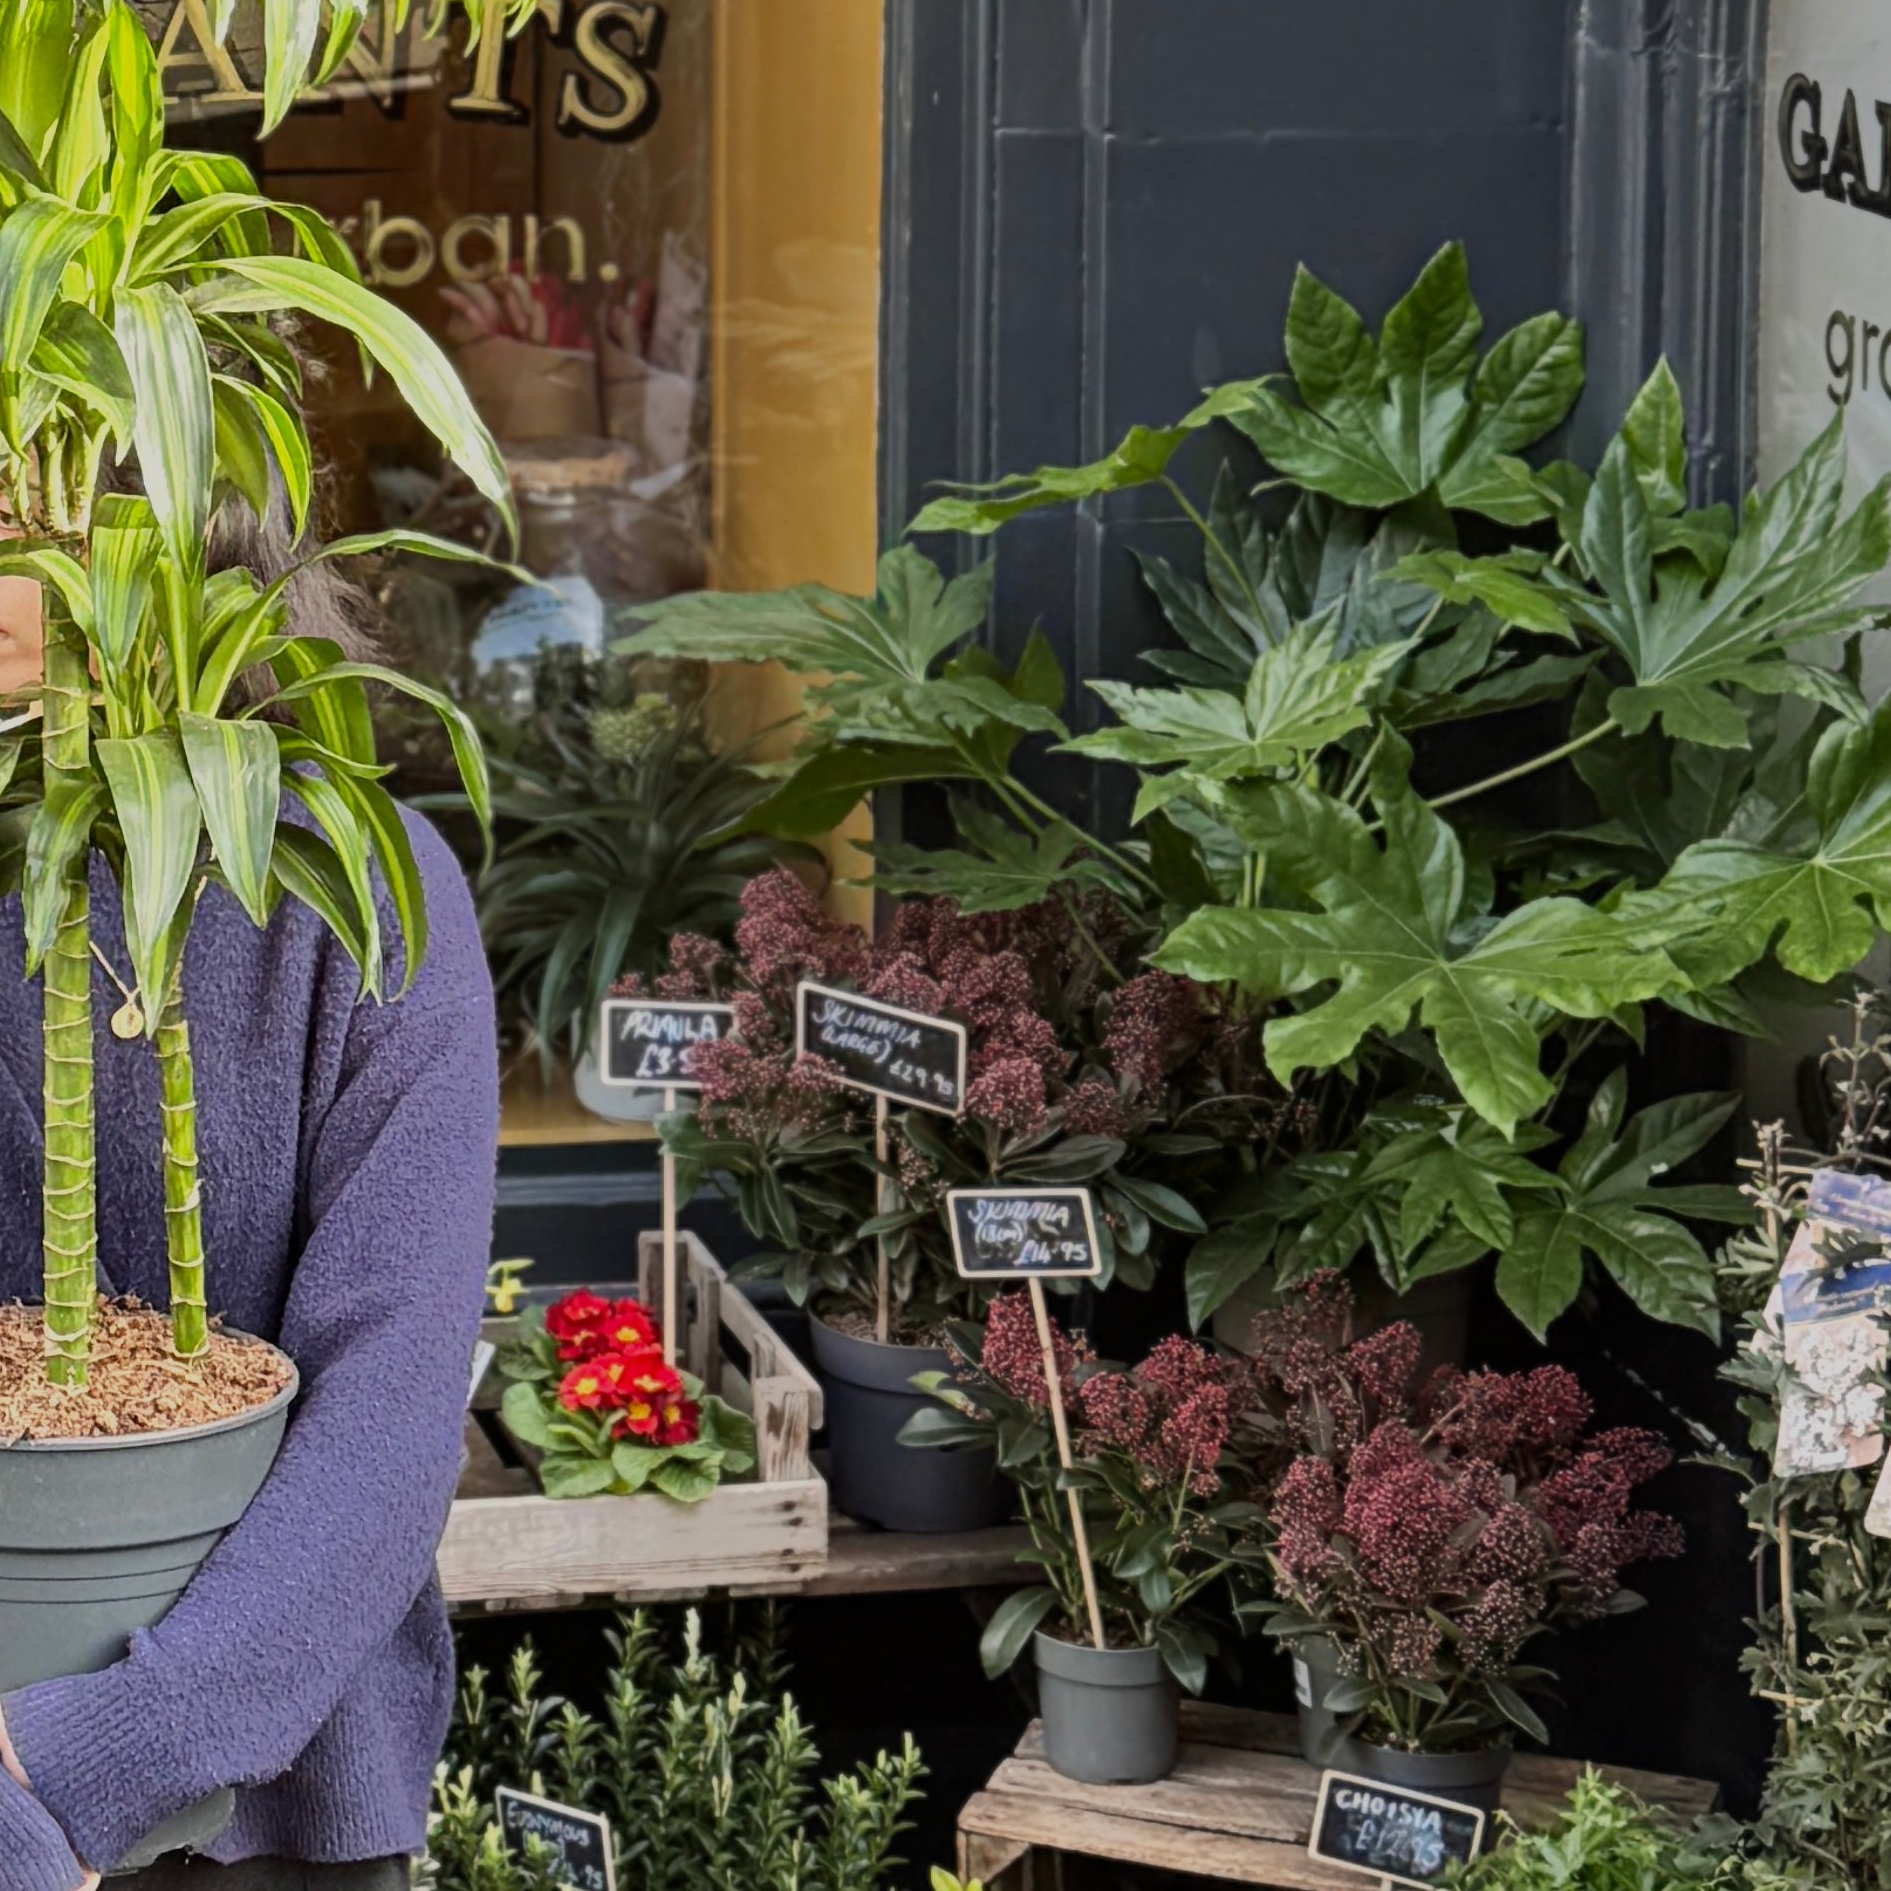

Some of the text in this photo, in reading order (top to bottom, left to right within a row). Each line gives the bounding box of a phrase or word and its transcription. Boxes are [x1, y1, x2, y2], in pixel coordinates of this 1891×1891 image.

[1778, 73, 1891, 220] GA
[812, 999, 922, 1049] SKIMMIA
[1335, 1789, 1443, 1834] CHOISYA
